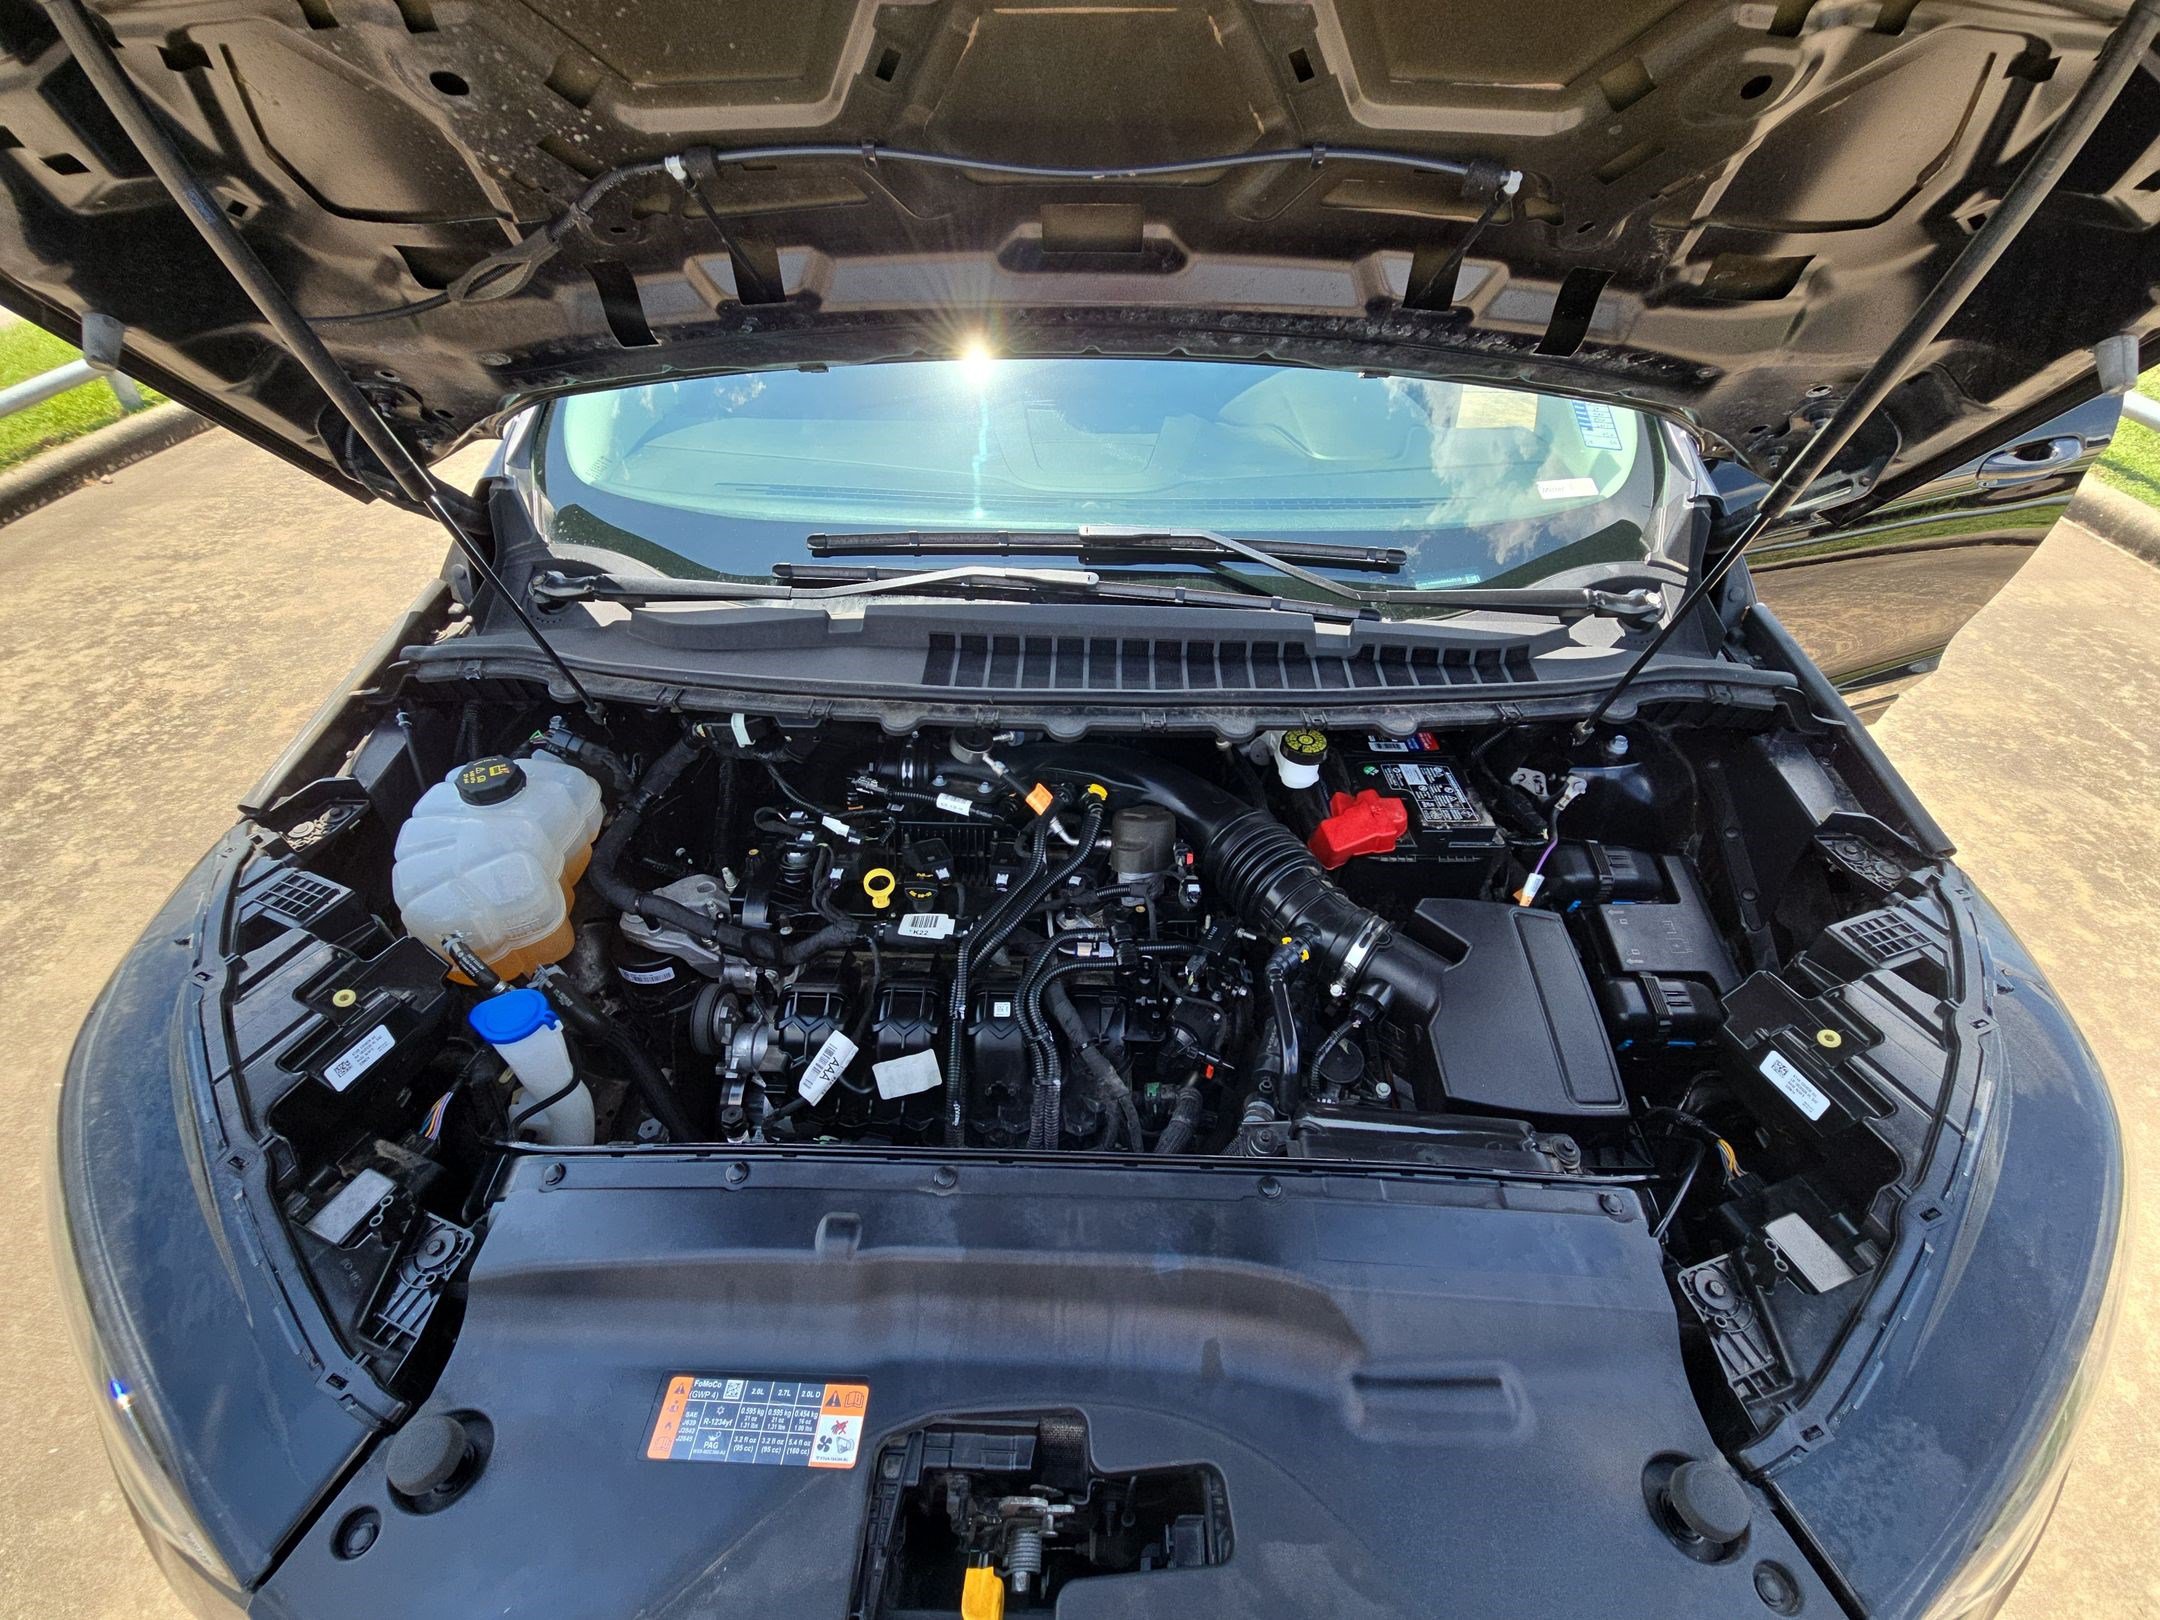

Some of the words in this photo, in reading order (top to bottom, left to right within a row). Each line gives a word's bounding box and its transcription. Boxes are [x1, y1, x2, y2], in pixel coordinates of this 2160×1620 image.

[820, 1056, 839, 1081] AAA
[694, 1379, 722, 1388] FoMoCo
[689, 1391, 710, 1399] (GWP
[711, 1392, 719, 1400] 4)
[741, 1407, 756, 1415] 0.595
[757, 1408, 764, 1416] kg
[768, 1408, 783, 1416] 0.595
[784, 1410, 792, 1418] kg
[811, 1411, 818, 1419] kg
[703, 1417, 733, 1427] R-1234yf
[734, 1444, 743, 1452] (95
[786, 1447, 799, 1455] (160
